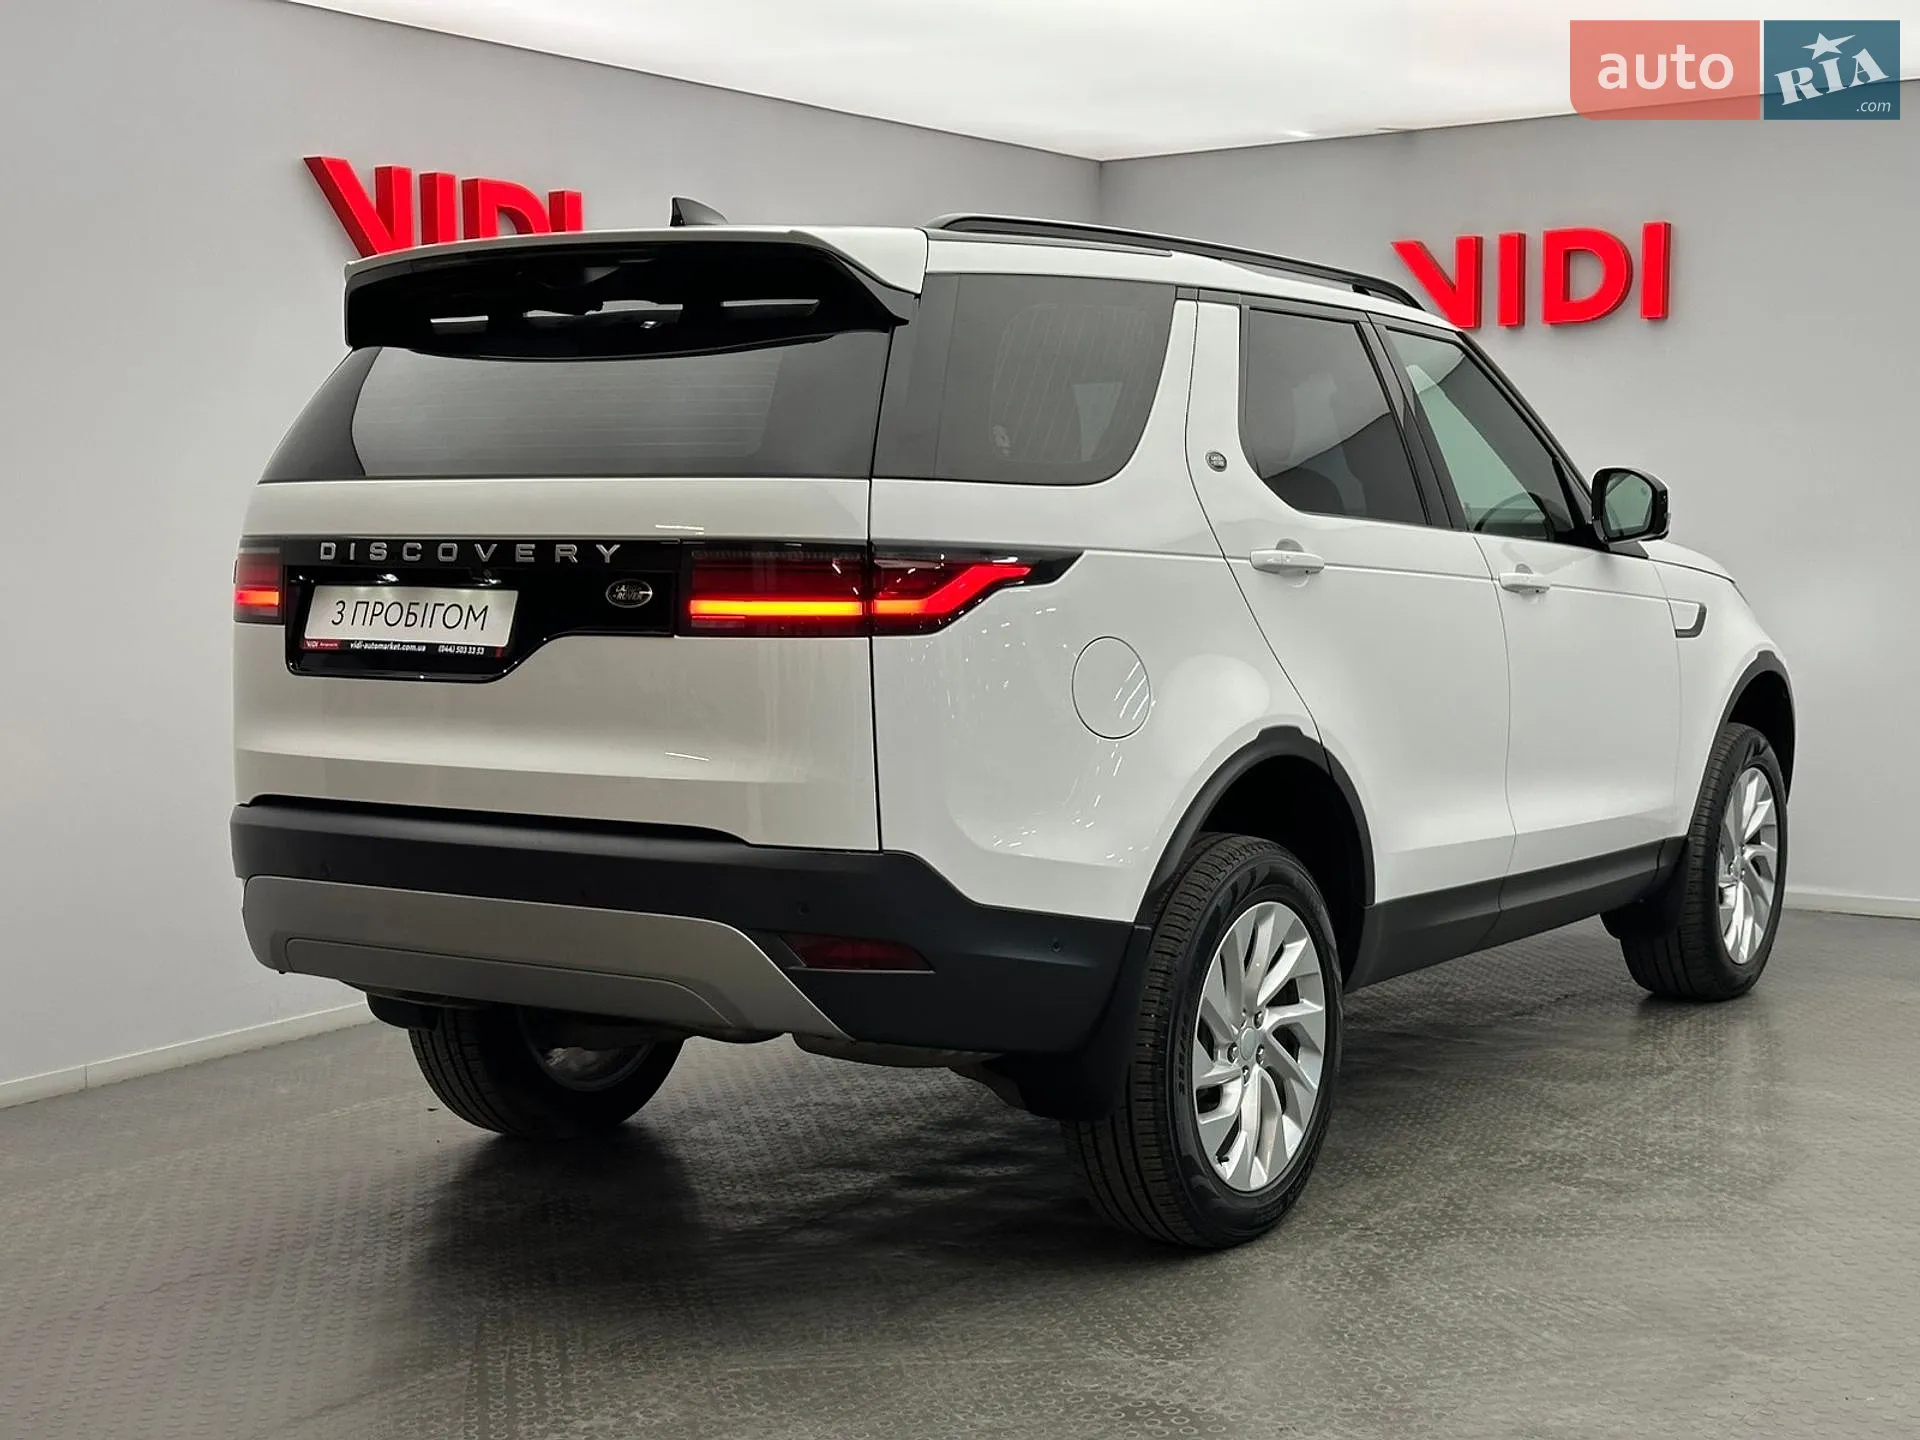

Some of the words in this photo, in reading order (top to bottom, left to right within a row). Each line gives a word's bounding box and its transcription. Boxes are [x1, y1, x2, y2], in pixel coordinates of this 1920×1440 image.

[303, 156, 583, 258] VIDI
[1390, 221, 1671, 329] VIDI
[320, 541, 622, 564] DISCOVERY
[350, 600, 489, 631] ПРОБІГОМ
